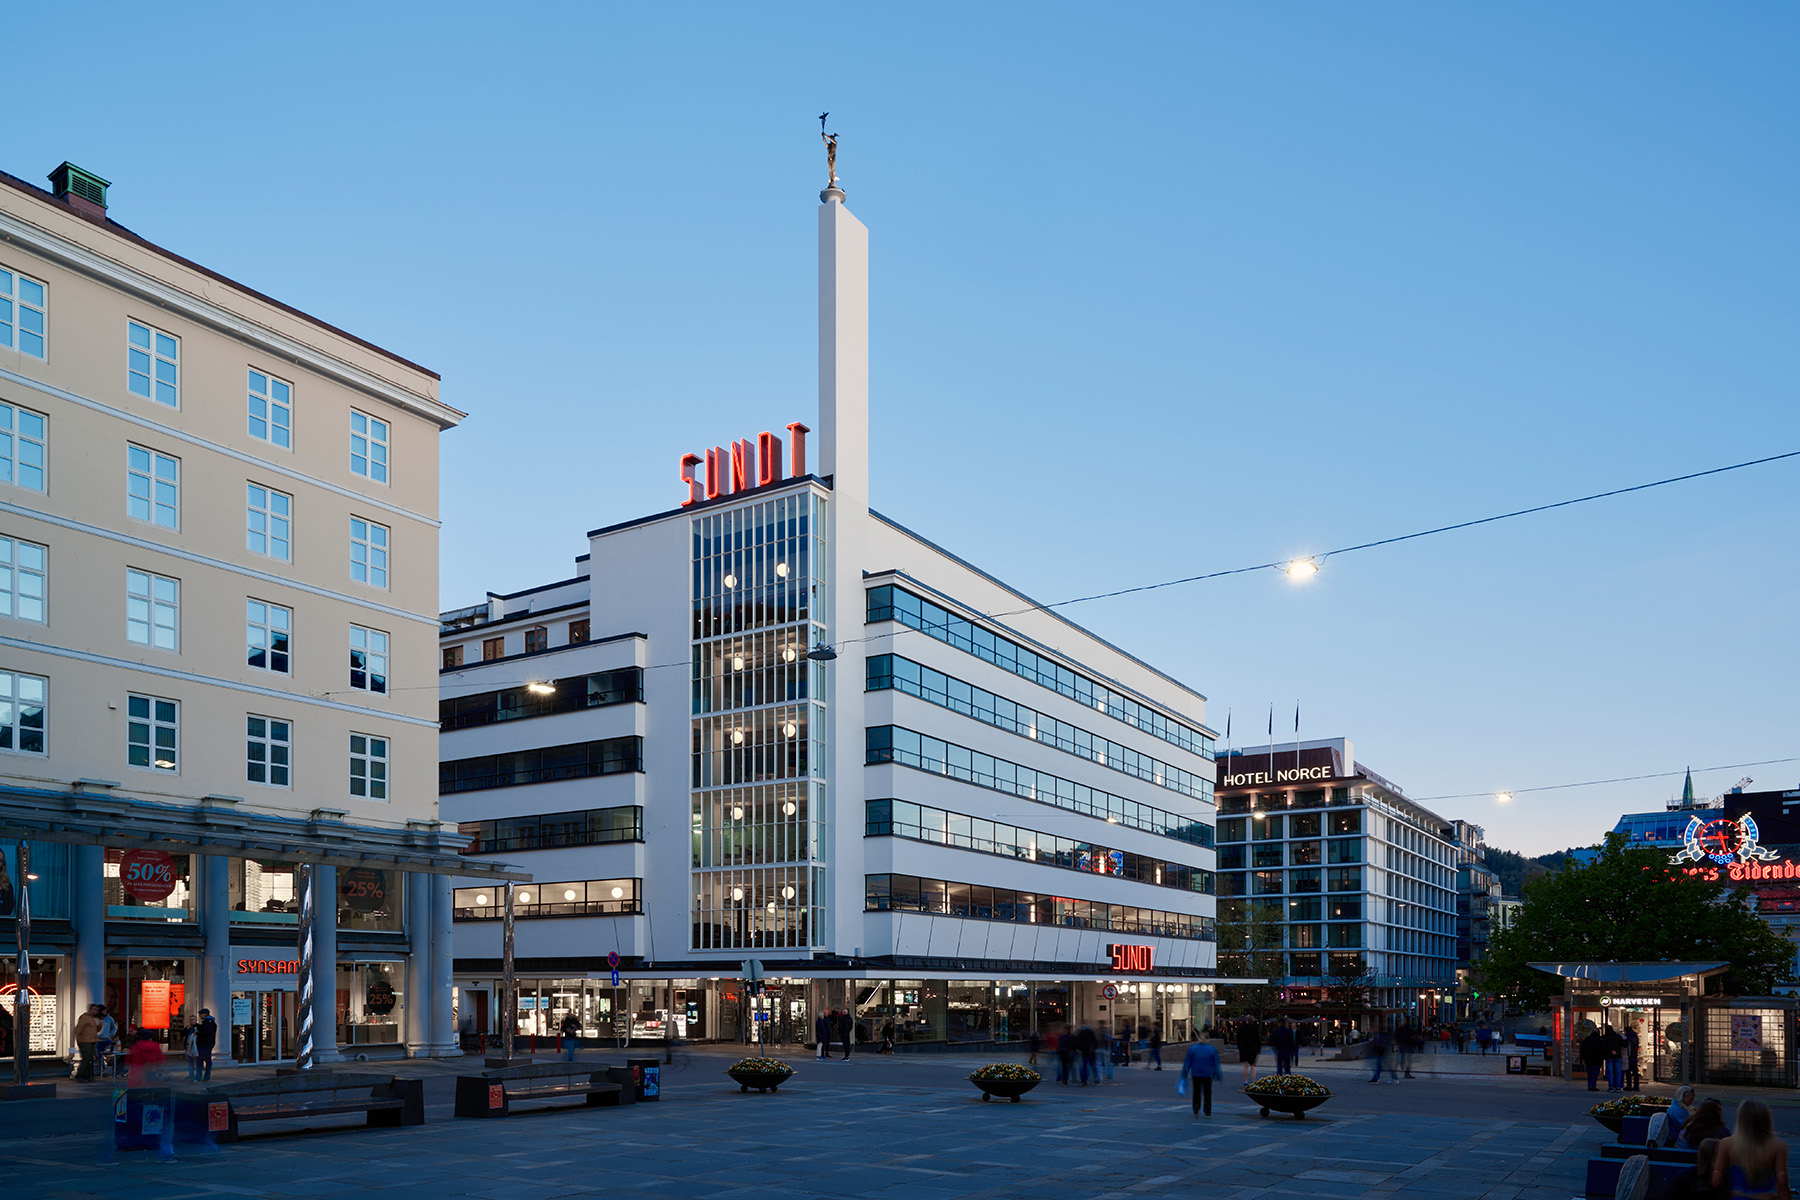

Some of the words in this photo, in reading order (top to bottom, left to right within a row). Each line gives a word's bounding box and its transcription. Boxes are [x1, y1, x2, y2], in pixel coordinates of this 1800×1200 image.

[680, 421, 811, 507] SUNDT
[1223, 771, 1273, 787] HOTEL
[1277, 766, 1331, 782] NORGE
[126, 862, 172, 882] 50%
[347, 880, 384, 898] 25%
[238, 959, 300, 974] SYNSAM
[1112, 943, 1156, 971] SUNDT
[368, 993, 394, 1005] 25%
[1612, 998, 1662, 1006] NARVESEN
